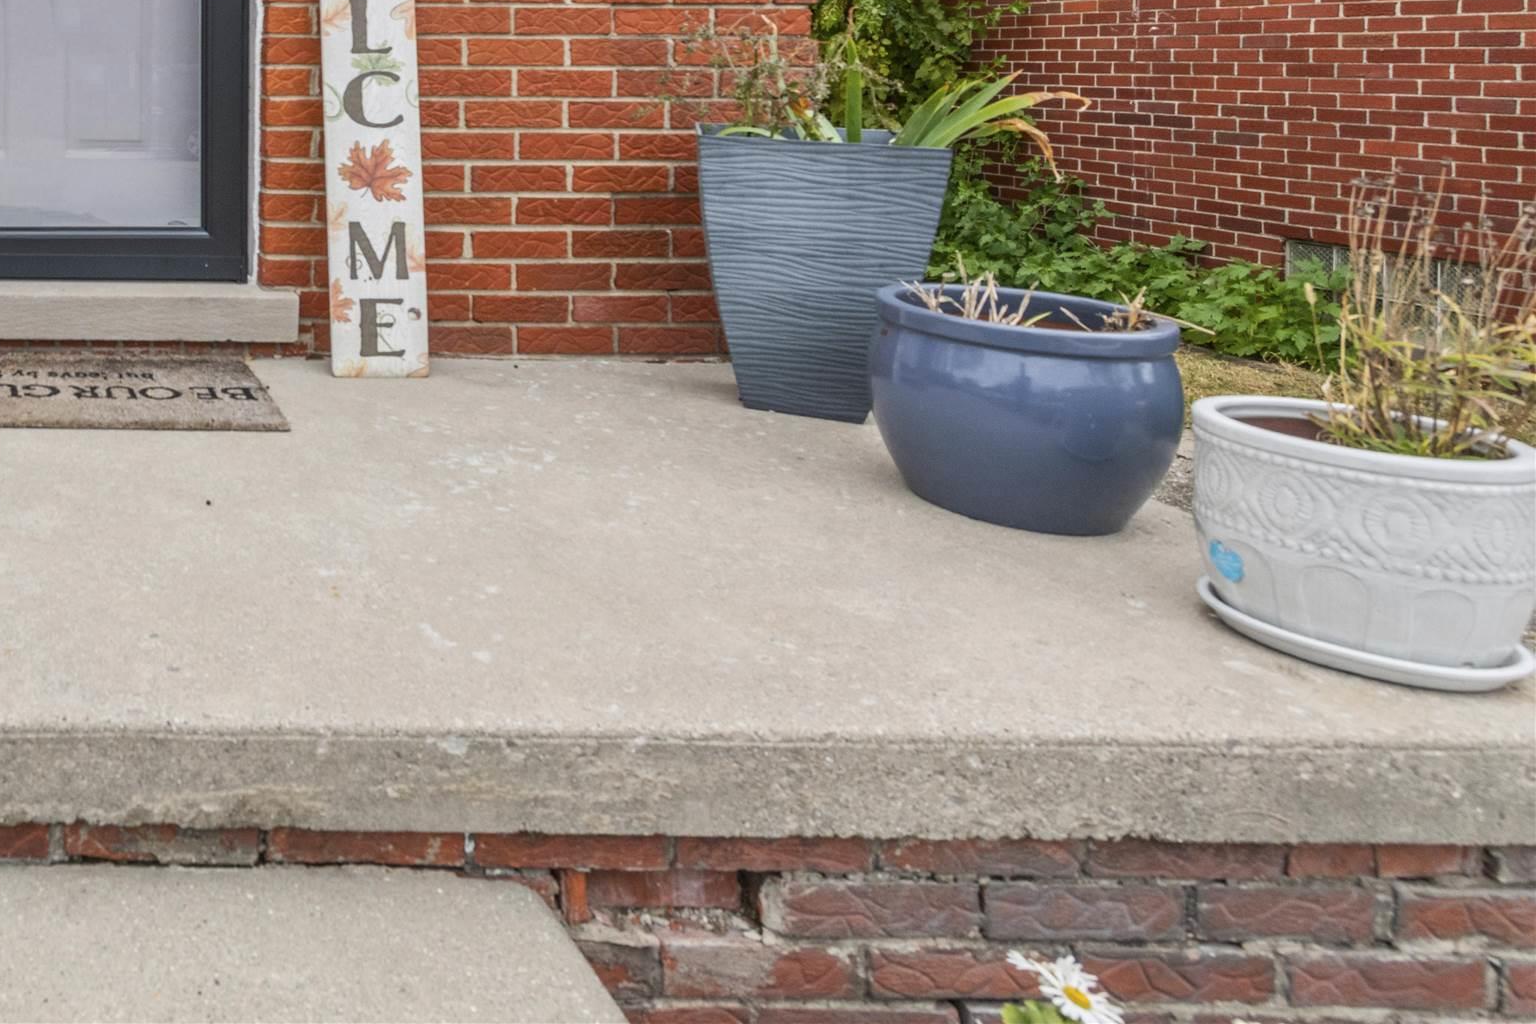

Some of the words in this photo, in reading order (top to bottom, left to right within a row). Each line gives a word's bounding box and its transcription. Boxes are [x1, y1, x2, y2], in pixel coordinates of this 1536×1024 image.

[11, 368, 39, 380] by
[116, 369, 156, 382] but
[68, 384, 184, 401] OUR
[188, 385, 259, 401] BE
